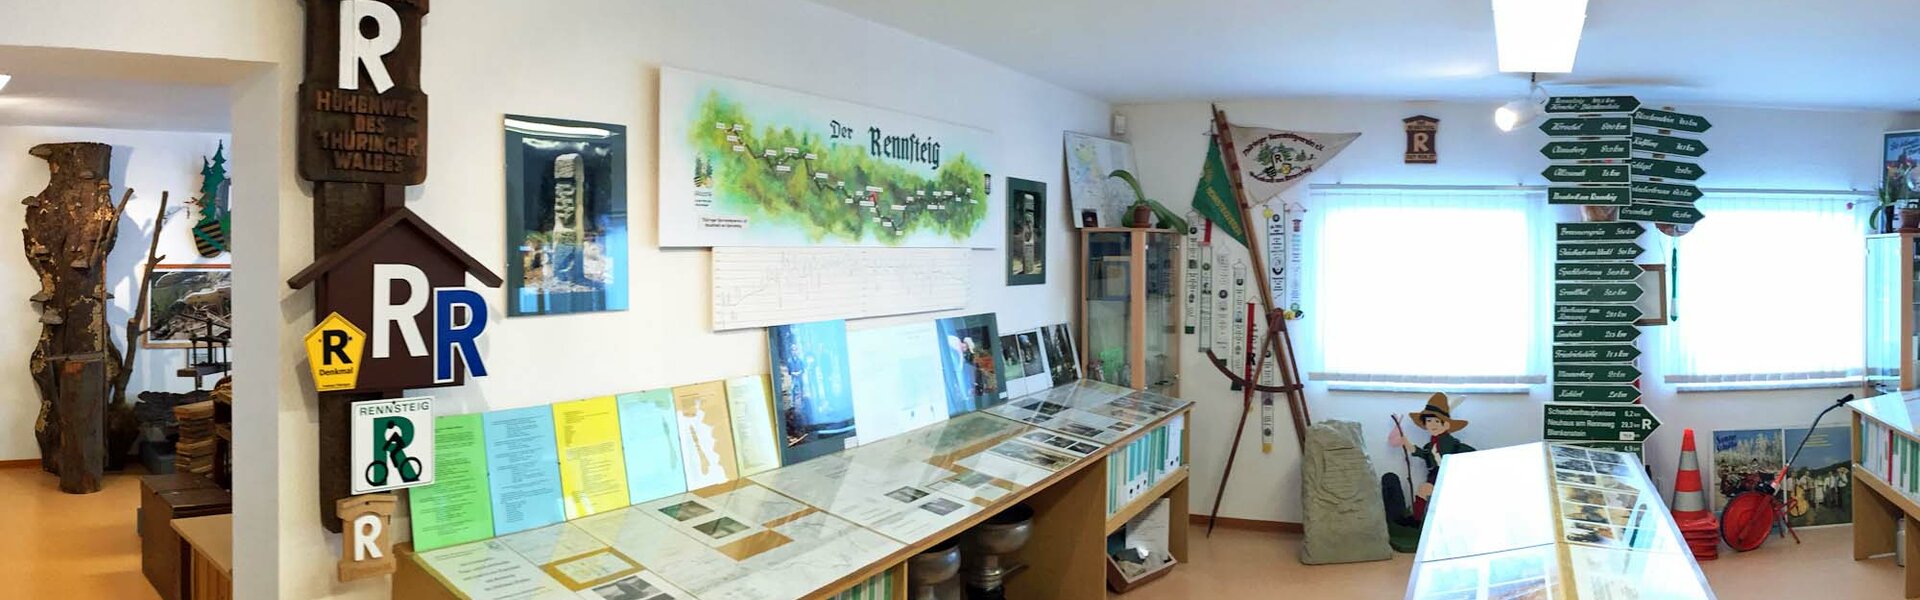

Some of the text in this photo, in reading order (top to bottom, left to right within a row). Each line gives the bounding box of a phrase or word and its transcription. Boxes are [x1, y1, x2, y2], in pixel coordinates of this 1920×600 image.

[338, 0, 402, 94] R
[355, 114, 385, 132] DES
[830, 120, 853, 139] Der
[1413, 133, 1429, 152] R
[372, 263, 430, 359] R
[322, 329, 353, 365] R
[433, 286, 488, 384] R
[319, 367, 354, 376] Denkmal
[359, 401, 430, 416] RENNSTEIG
[1641, 418, 1652, 430] R
[373, 416, 420, 486] R
[354, 514, 384, 562] R
